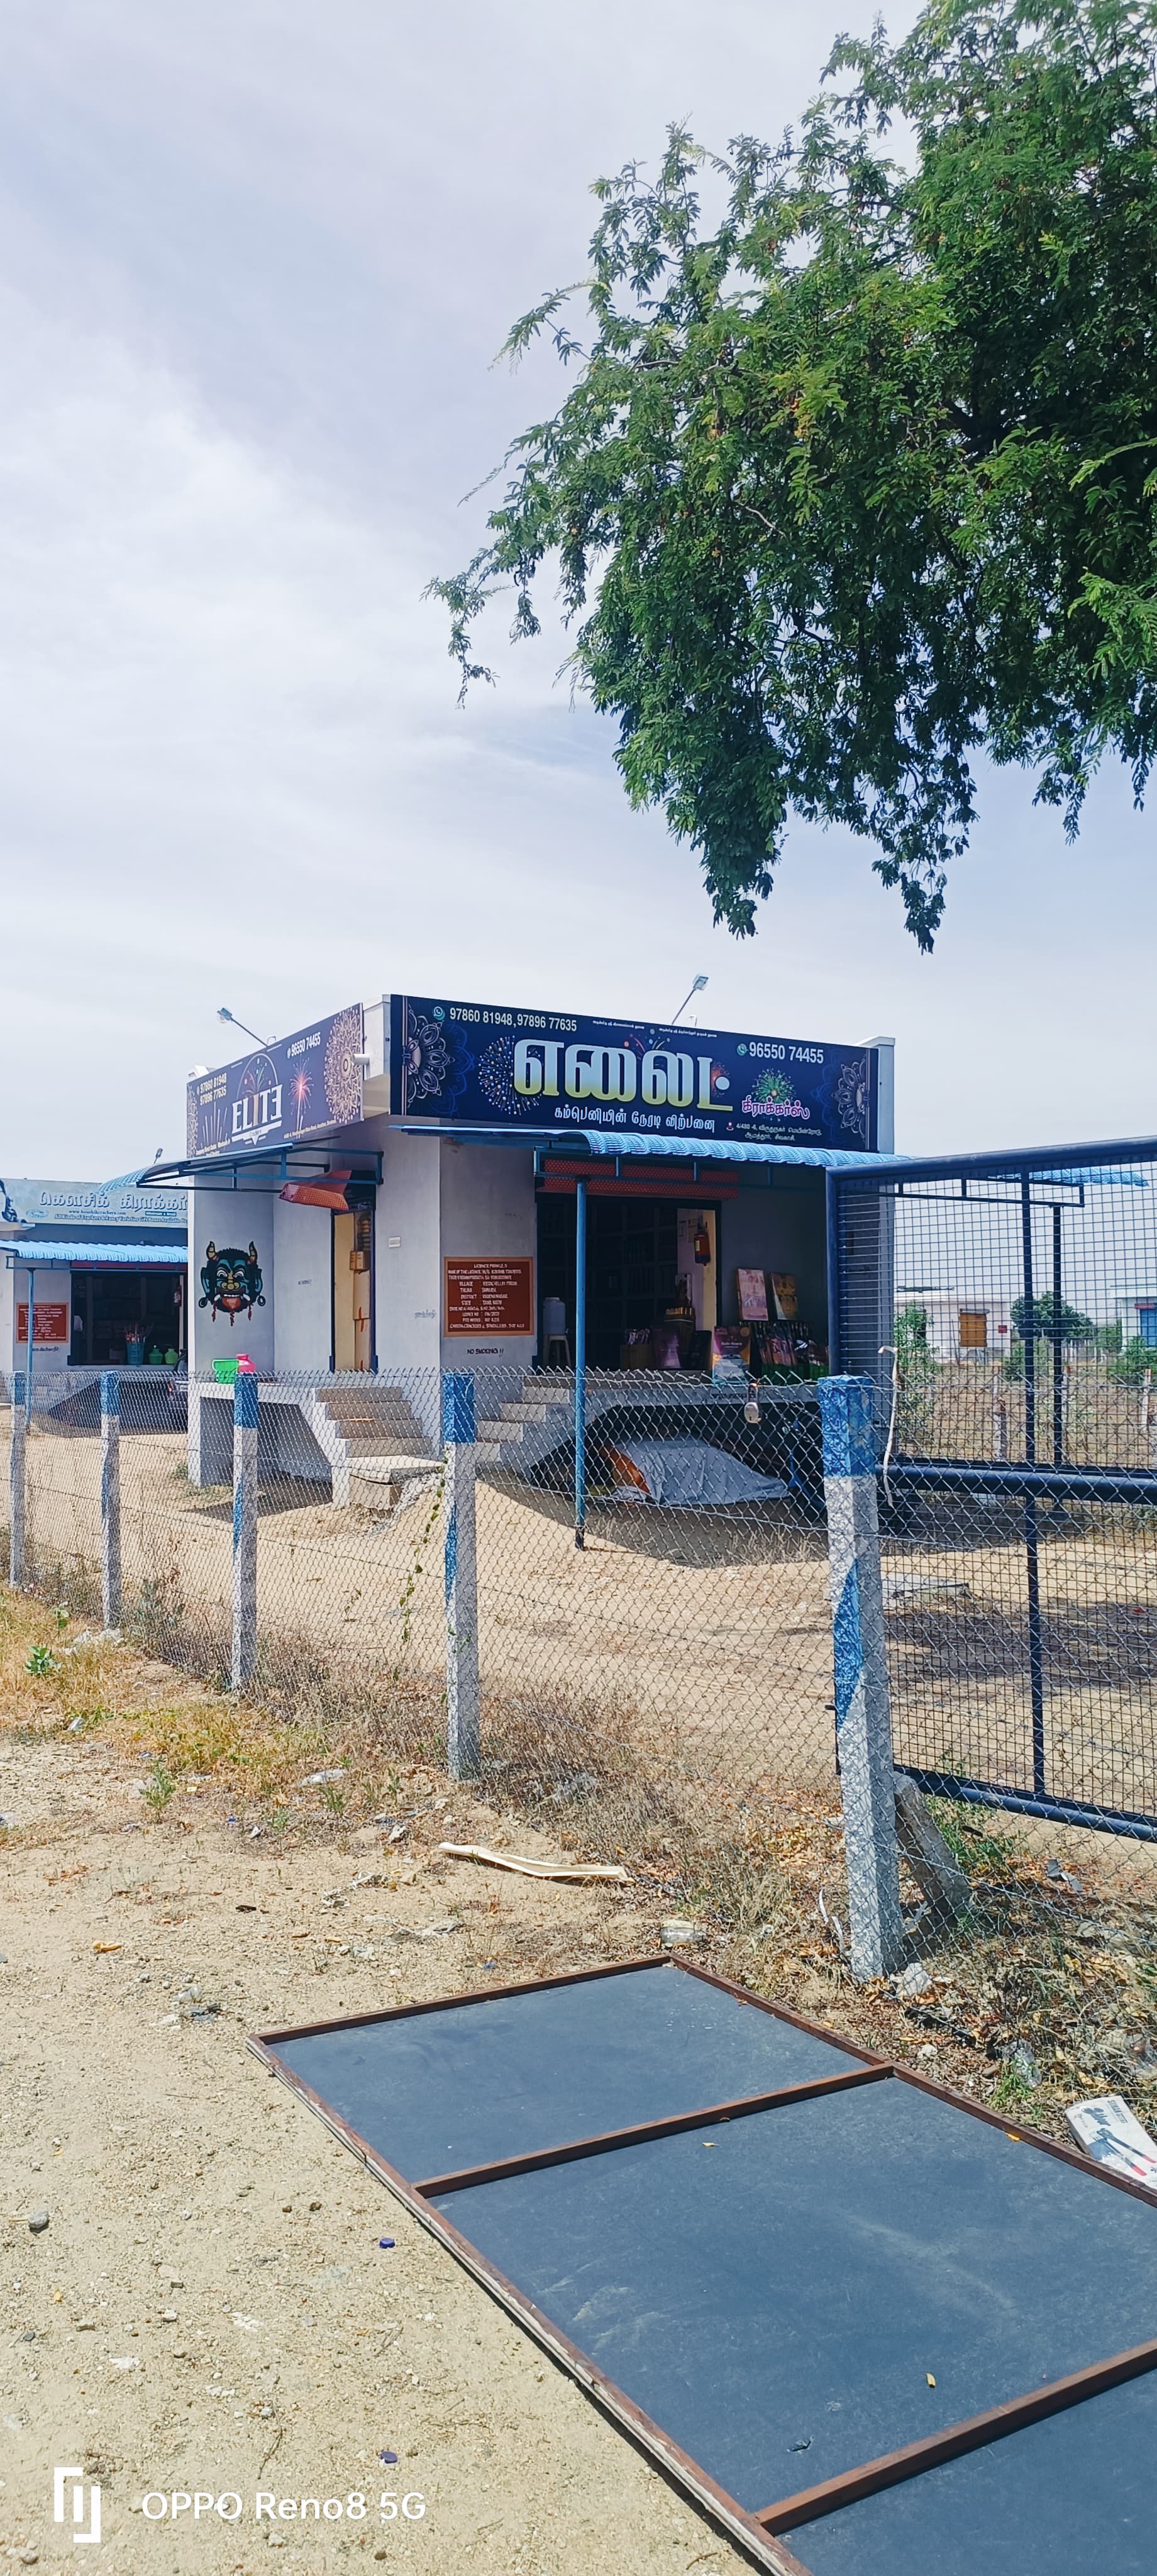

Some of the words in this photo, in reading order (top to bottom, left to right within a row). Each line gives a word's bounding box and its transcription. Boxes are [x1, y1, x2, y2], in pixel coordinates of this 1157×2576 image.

[450, 1008, 480, 1023] 97860
[548, 1017, 577, 1032] 77635
[292, 1038, 306, 1057] 96550
[306, 1031, 321, 1050] 74455
[748, 1041, 786, 1061] 96550
[789, 1045, 824, 1064] 74455
[200, 1079, 213, 1094] 97860
[213, 1072, 227, 1088] 81948
[199, 1091, 213, 1106] 97896
[213, 1085, 227, 1101] 77635
[741, 1095, 811, 1120] கிராக்கர்ஸ்
[231, 1084, 283, 1135] ELITE
[554, 1104, 627, 1125] கம்பெனியின்
[631, 1111, 662, 1129] நேரடி
[665, 1113, 716, 1133] விற்பனை
